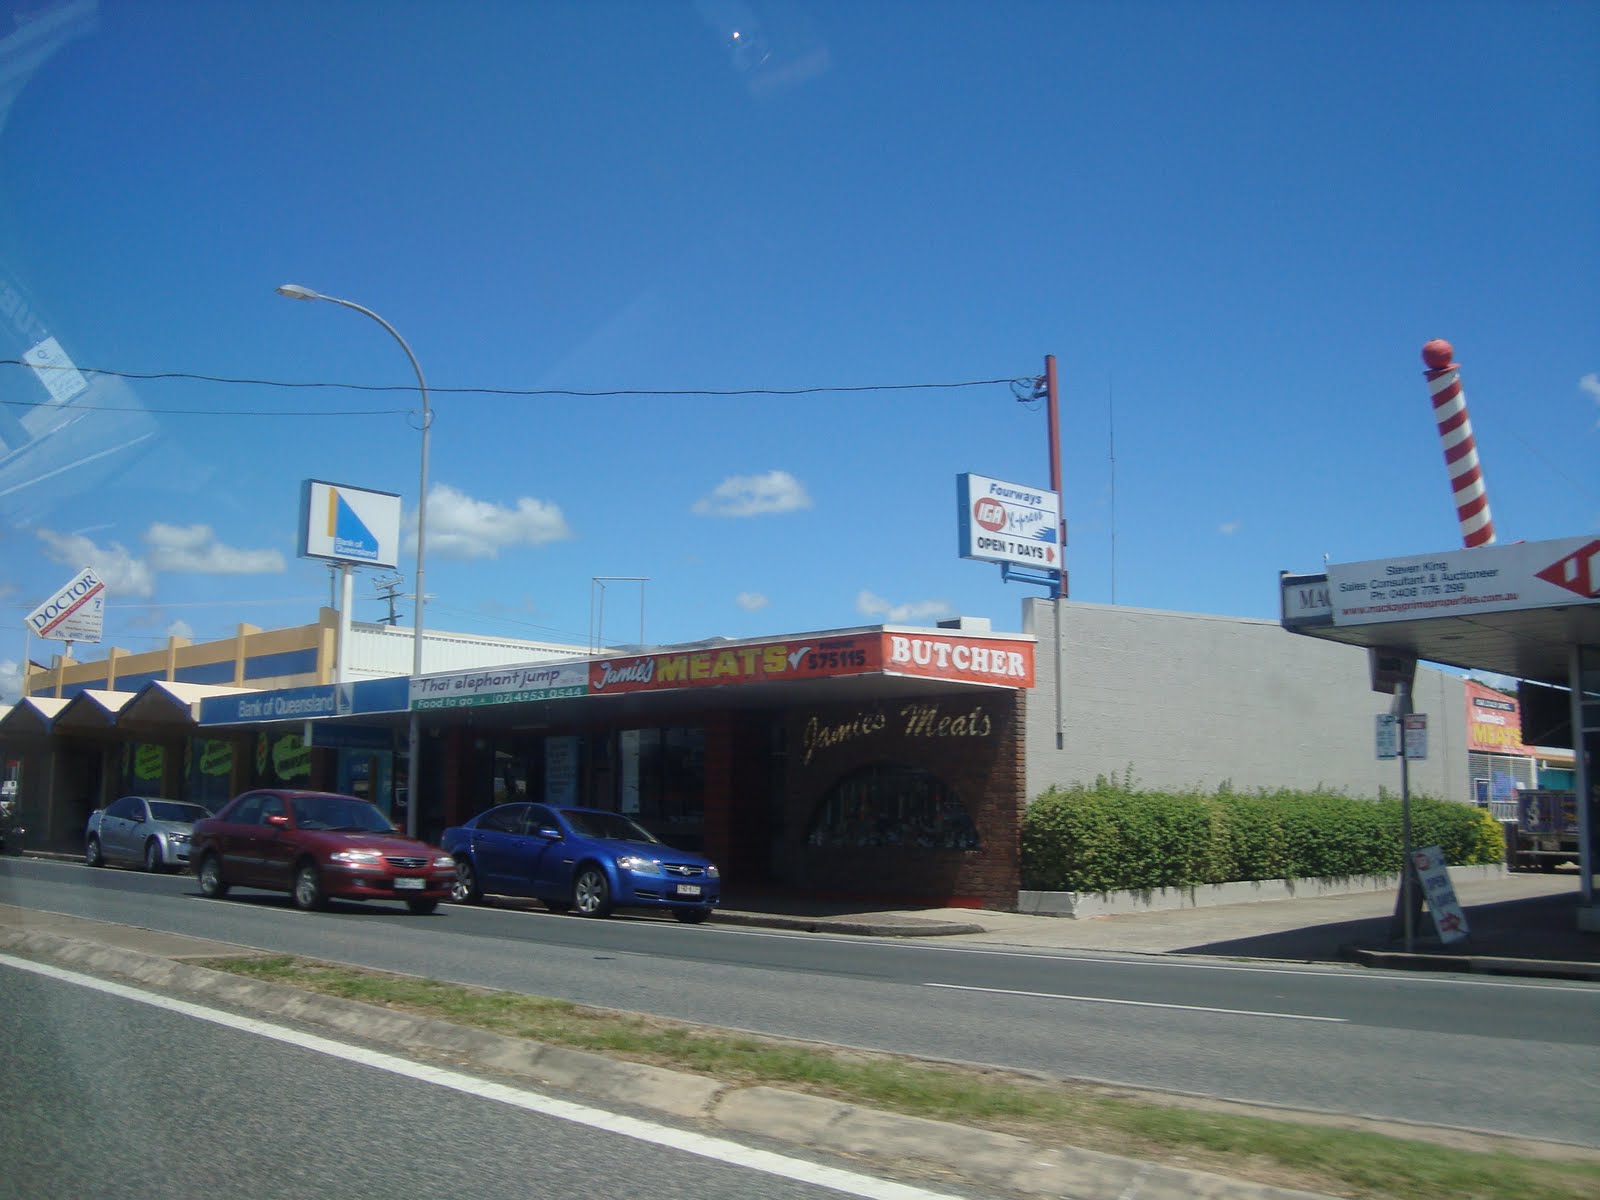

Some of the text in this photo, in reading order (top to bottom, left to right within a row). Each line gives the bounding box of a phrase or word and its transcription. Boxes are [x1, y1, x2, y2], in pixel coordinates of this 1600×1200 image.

[989, 483, 1042, 505] Fourways
[977, 536, 1043, 559] OPEN 7 DAYS
[1423, 562, 1448, 572] King
[1339, 569, 1499, 593] Sales Consultant & Auctioneer
[32, 574, 98, 629] DOCTOR
[593, 645, 865, 690] Jamie's MEATS 575115
[890, 635, 1026, 678] BUTCHER
[420, 678, 451, 692] Thai
[455, 672, 519, 692] elephant
[519, 669, 561, 689] jump
[239, 693, 335, 718] Bank of Queensland
[418, 698, 444, 709] Food
[445, 697, 456, 707] to
[515, 690, 545, 702] 4953
[550, 687, 582, 698] 0544
[900, 703, 991, 737] Meats
[1472, 724, 1523, 747] MEATS
